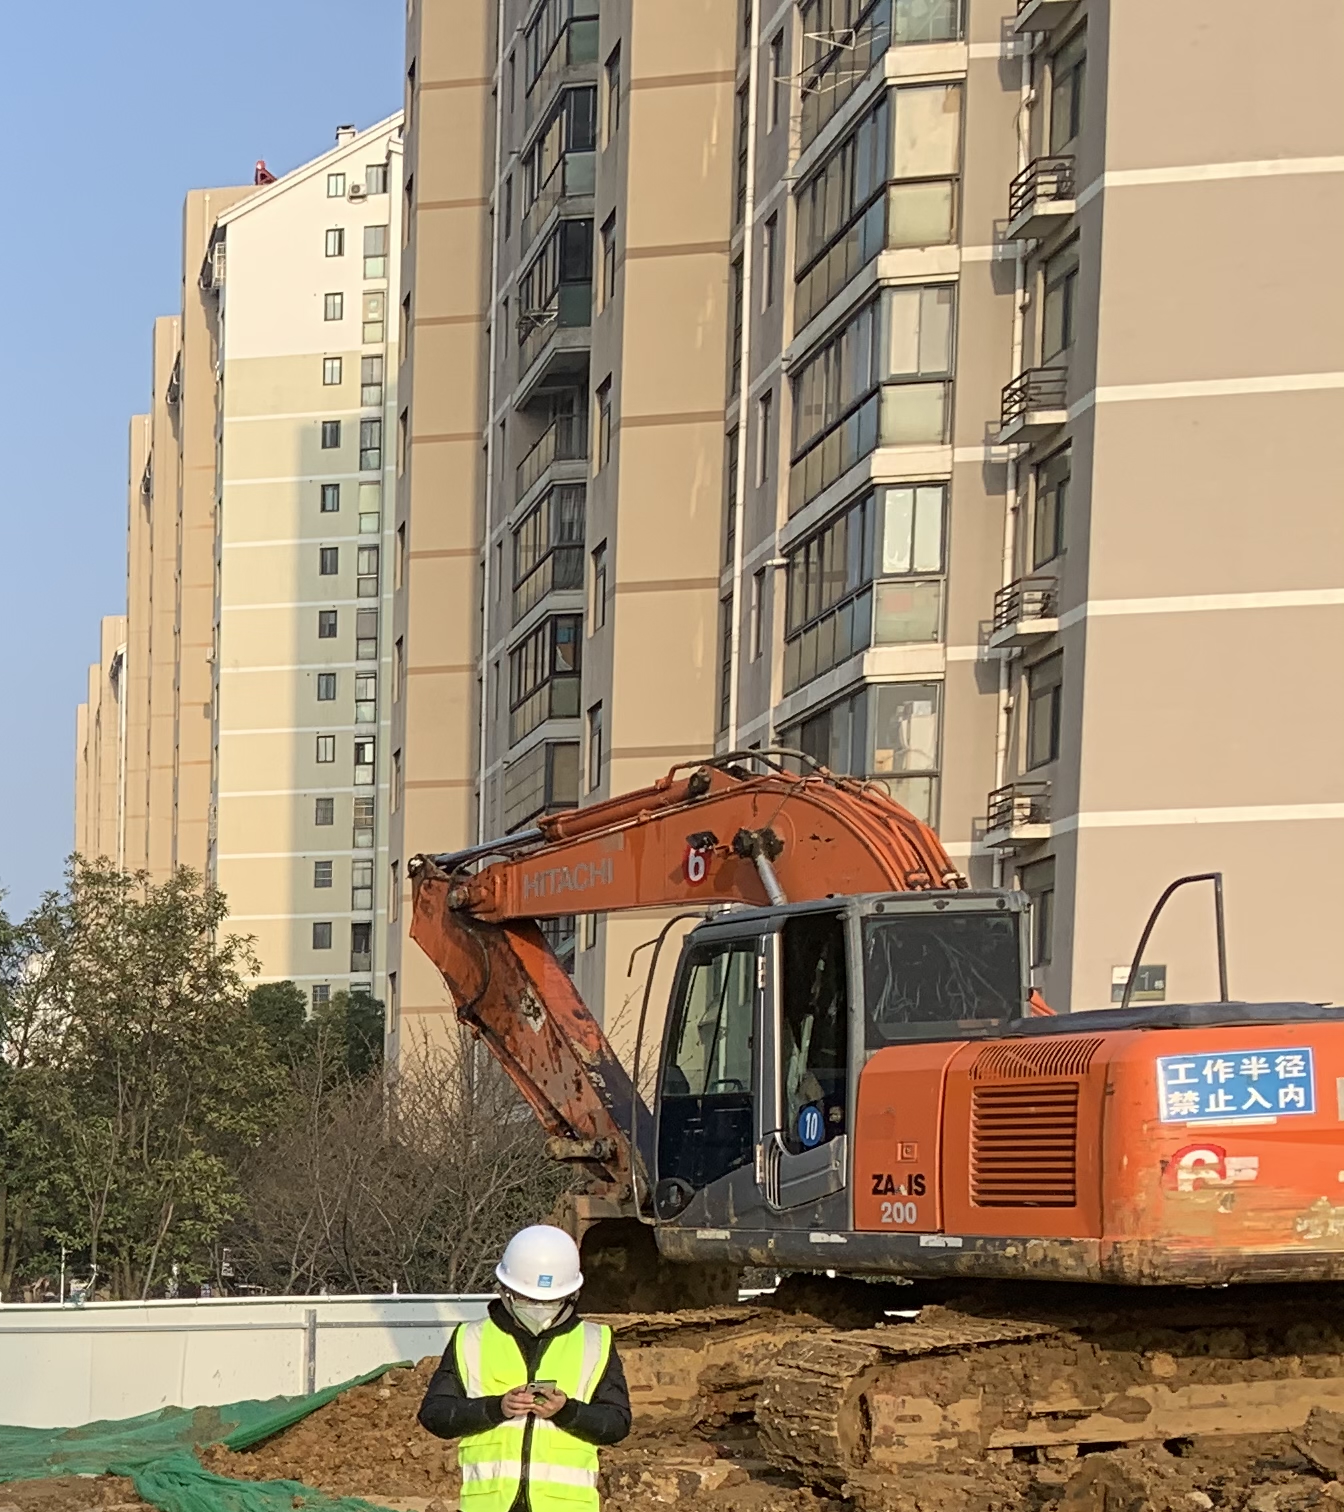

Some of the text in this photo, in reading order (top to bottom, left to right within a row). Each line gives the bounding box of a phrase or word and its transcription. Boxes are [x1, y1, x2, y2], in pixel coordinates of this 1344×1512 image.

[523, 857, 614, 900] HITACHI
[1166, 1054, 1307, 1086] 工作半径
[1167, 1083, 1306, 1116] 禁止入内
[805, 1112, 818, 1141] 10
[871, 1173, 926, 1197] ZAIS
[880, 1201, 917, 1225] 200
